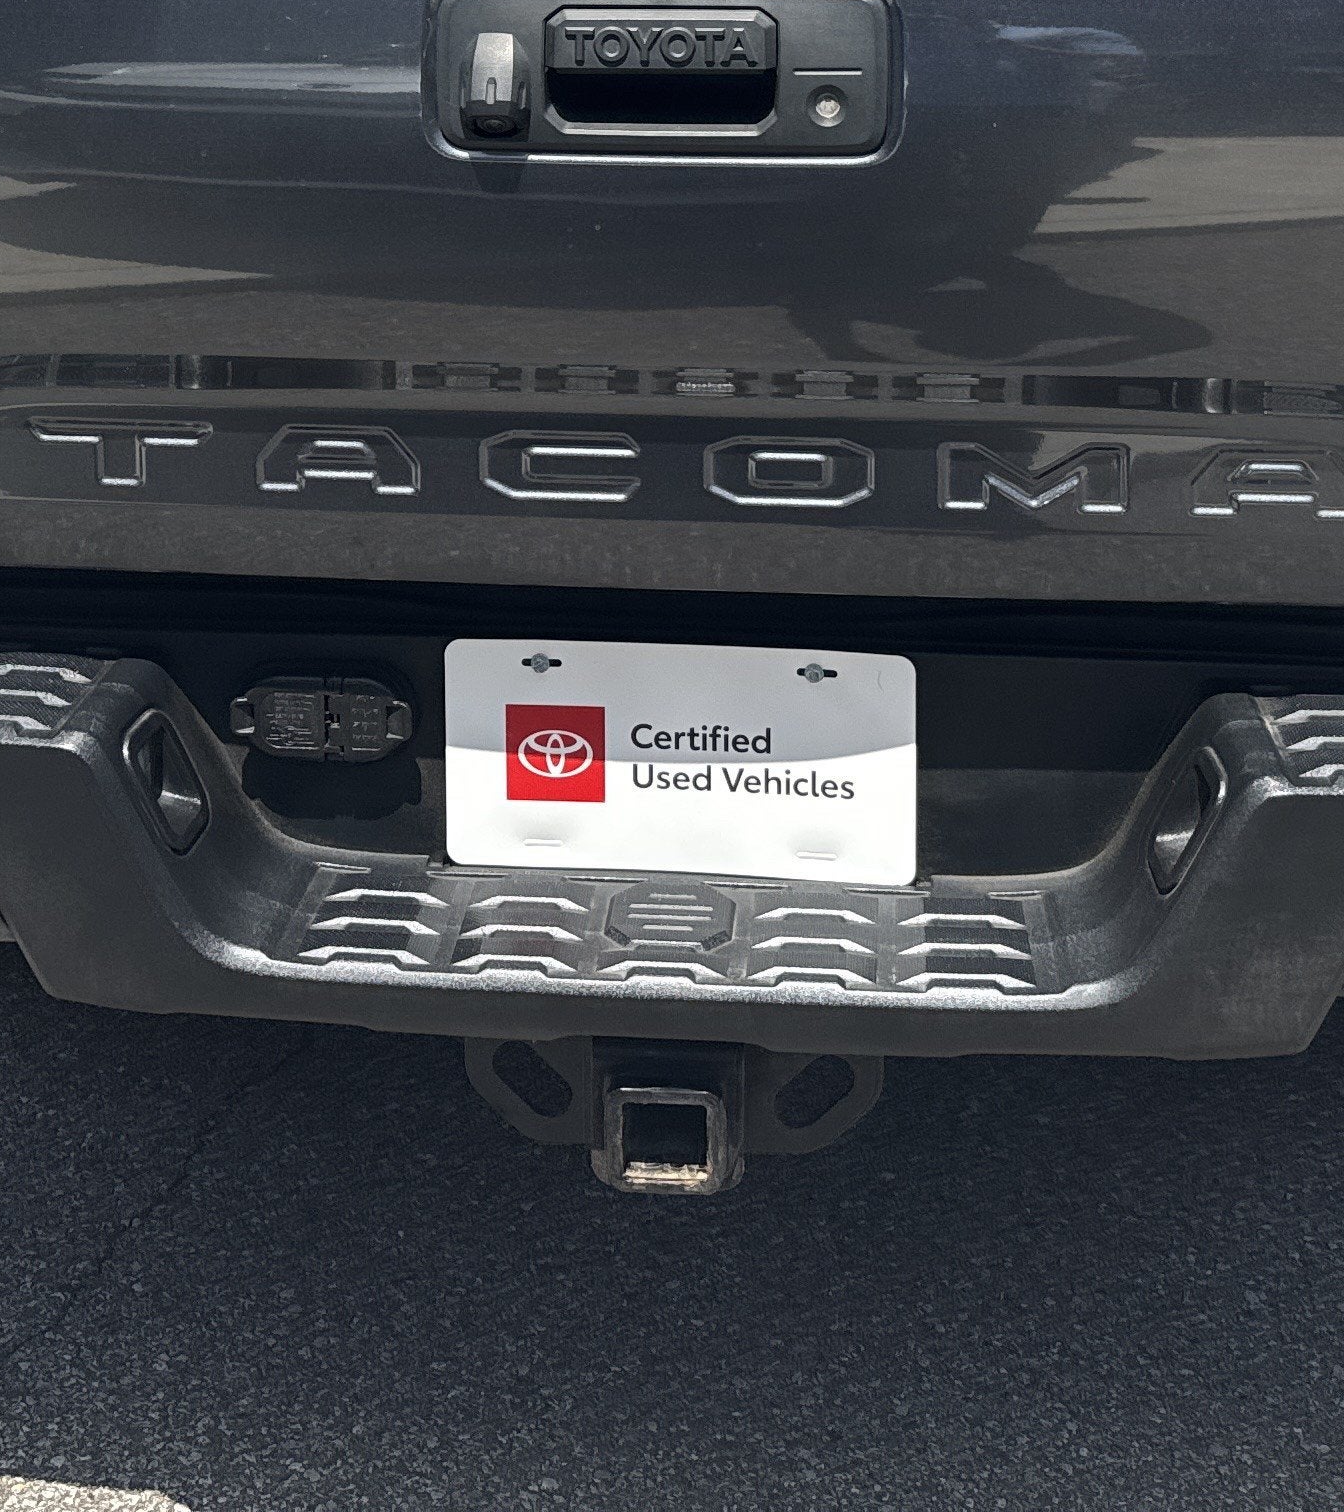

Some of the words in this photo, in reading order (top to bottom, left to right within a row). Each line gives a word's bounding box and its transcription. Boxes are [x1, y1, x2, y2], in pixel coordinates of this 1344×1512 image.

[564, 25, 759, 68] TOYOTA
[629, 722, 773, 755] Certified
[631, 762, 713, 792] Used
[721, 767, 856, 800] Vehicles
